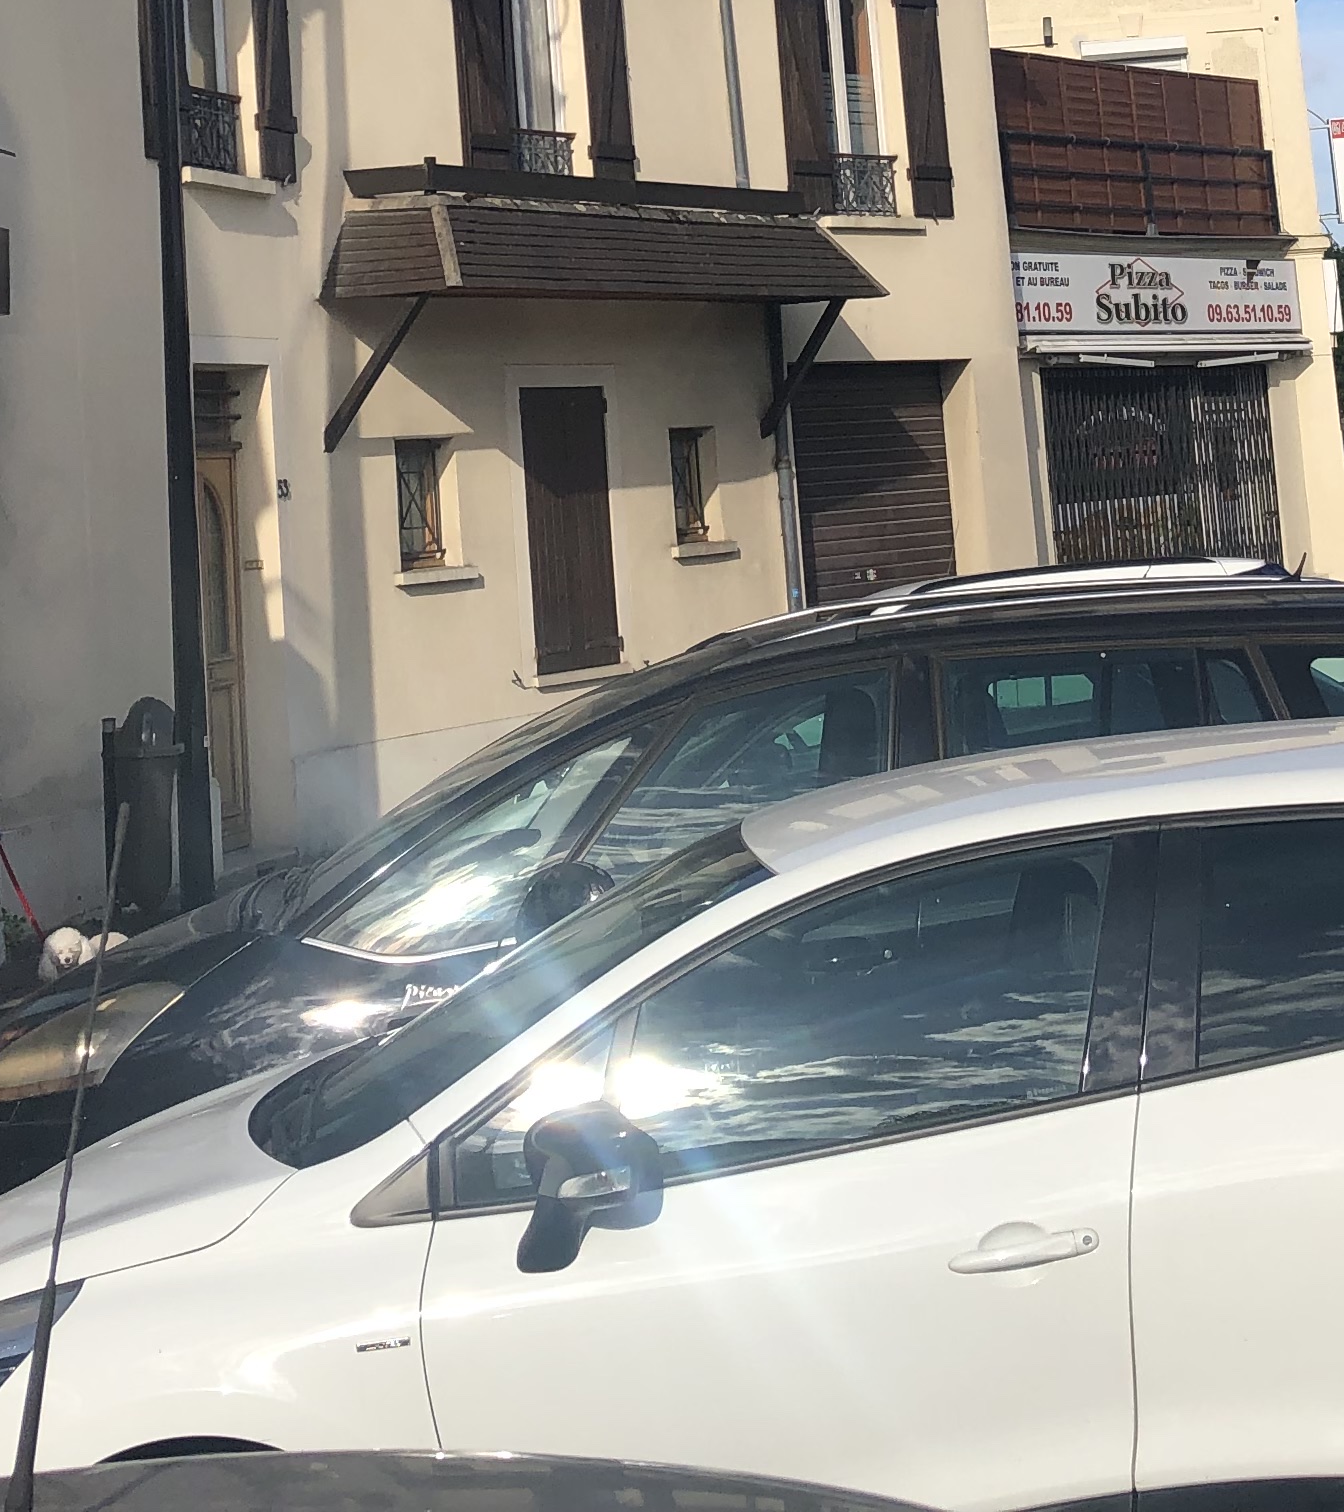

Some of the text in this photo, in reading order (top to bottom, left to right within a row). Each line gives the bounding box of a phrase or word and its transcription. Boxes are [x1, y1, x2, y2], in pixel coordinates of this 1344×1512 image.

[1022, 261, 1059, 272] GRATUITE
[1219, 267, 1238, 277] PIZZA
[1016, 276, 1069, 287] ET AU BUREAU
[1108, 263, 1173, 289] Pizza
[1096, 293, 1188, 324] Subito
[1207, 303, 1292, 323] 09.63.51.10.59
